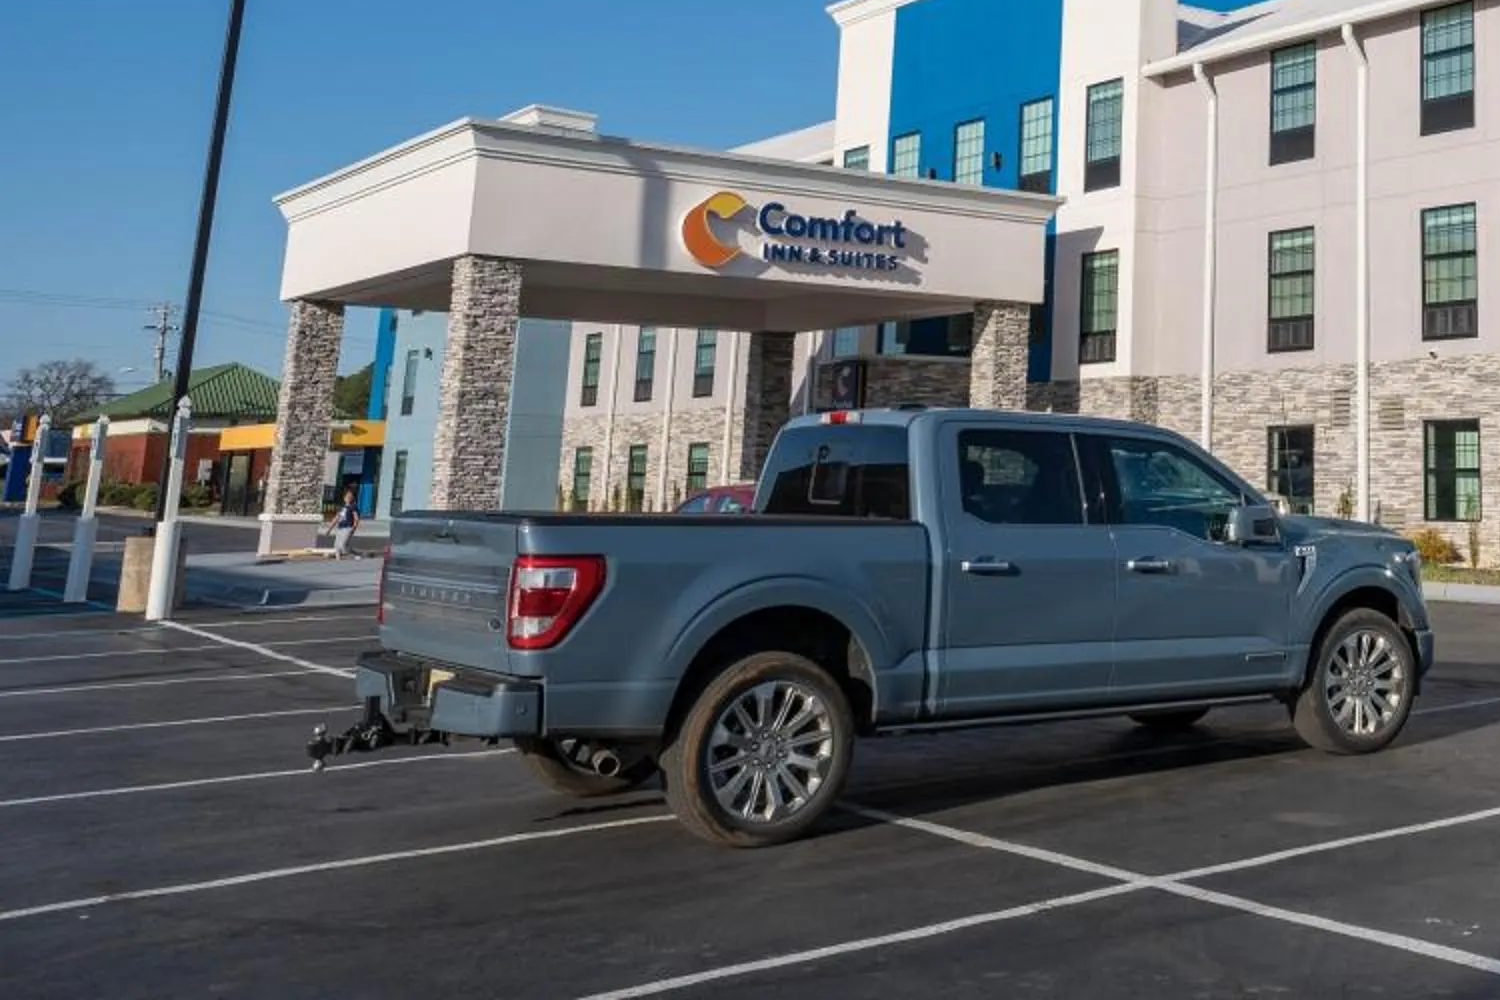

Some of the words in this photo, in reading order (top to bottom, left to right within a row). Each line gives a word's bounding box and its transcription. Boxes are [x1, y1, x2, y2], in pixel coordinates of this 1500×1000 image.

[758, 201, 906, 248] Comfort
[763, 243, 802, 261] INN
[808, 247, 820, 262] &
[828, 249, 898, 270] SUITES
